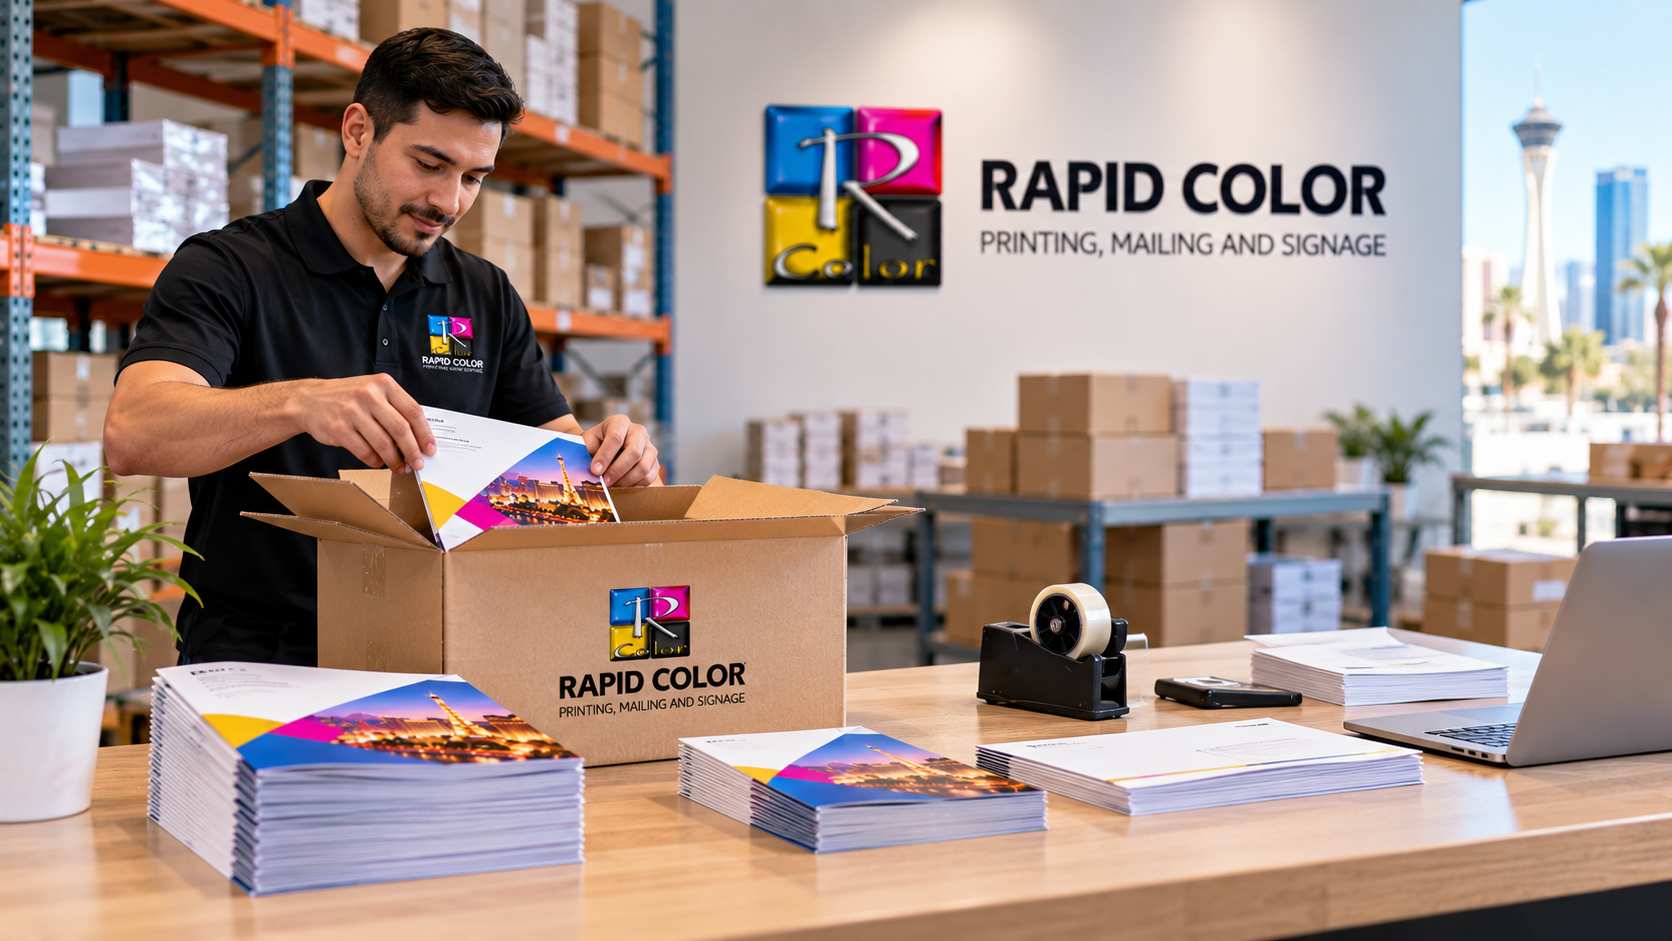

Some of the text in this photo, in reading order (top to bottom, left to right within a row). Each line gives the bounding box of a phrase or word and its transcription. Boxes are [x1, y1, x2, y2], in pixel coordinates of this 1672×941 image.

[980, 160, 1387, 216] RAPID COLOR
[980, 231, 1387, 258] PRINTING, MAILING AND SIGNAGE
[772, 243, 937, 282] Color
[422, 356, 484, 368] RAPID COLOR
[614, 641, 688, 658] Color
[559, 662, 746, 699] RAPID COLOR
[559, 692, 746, 718] PRINTING, MAILING AND SIGNAGE
